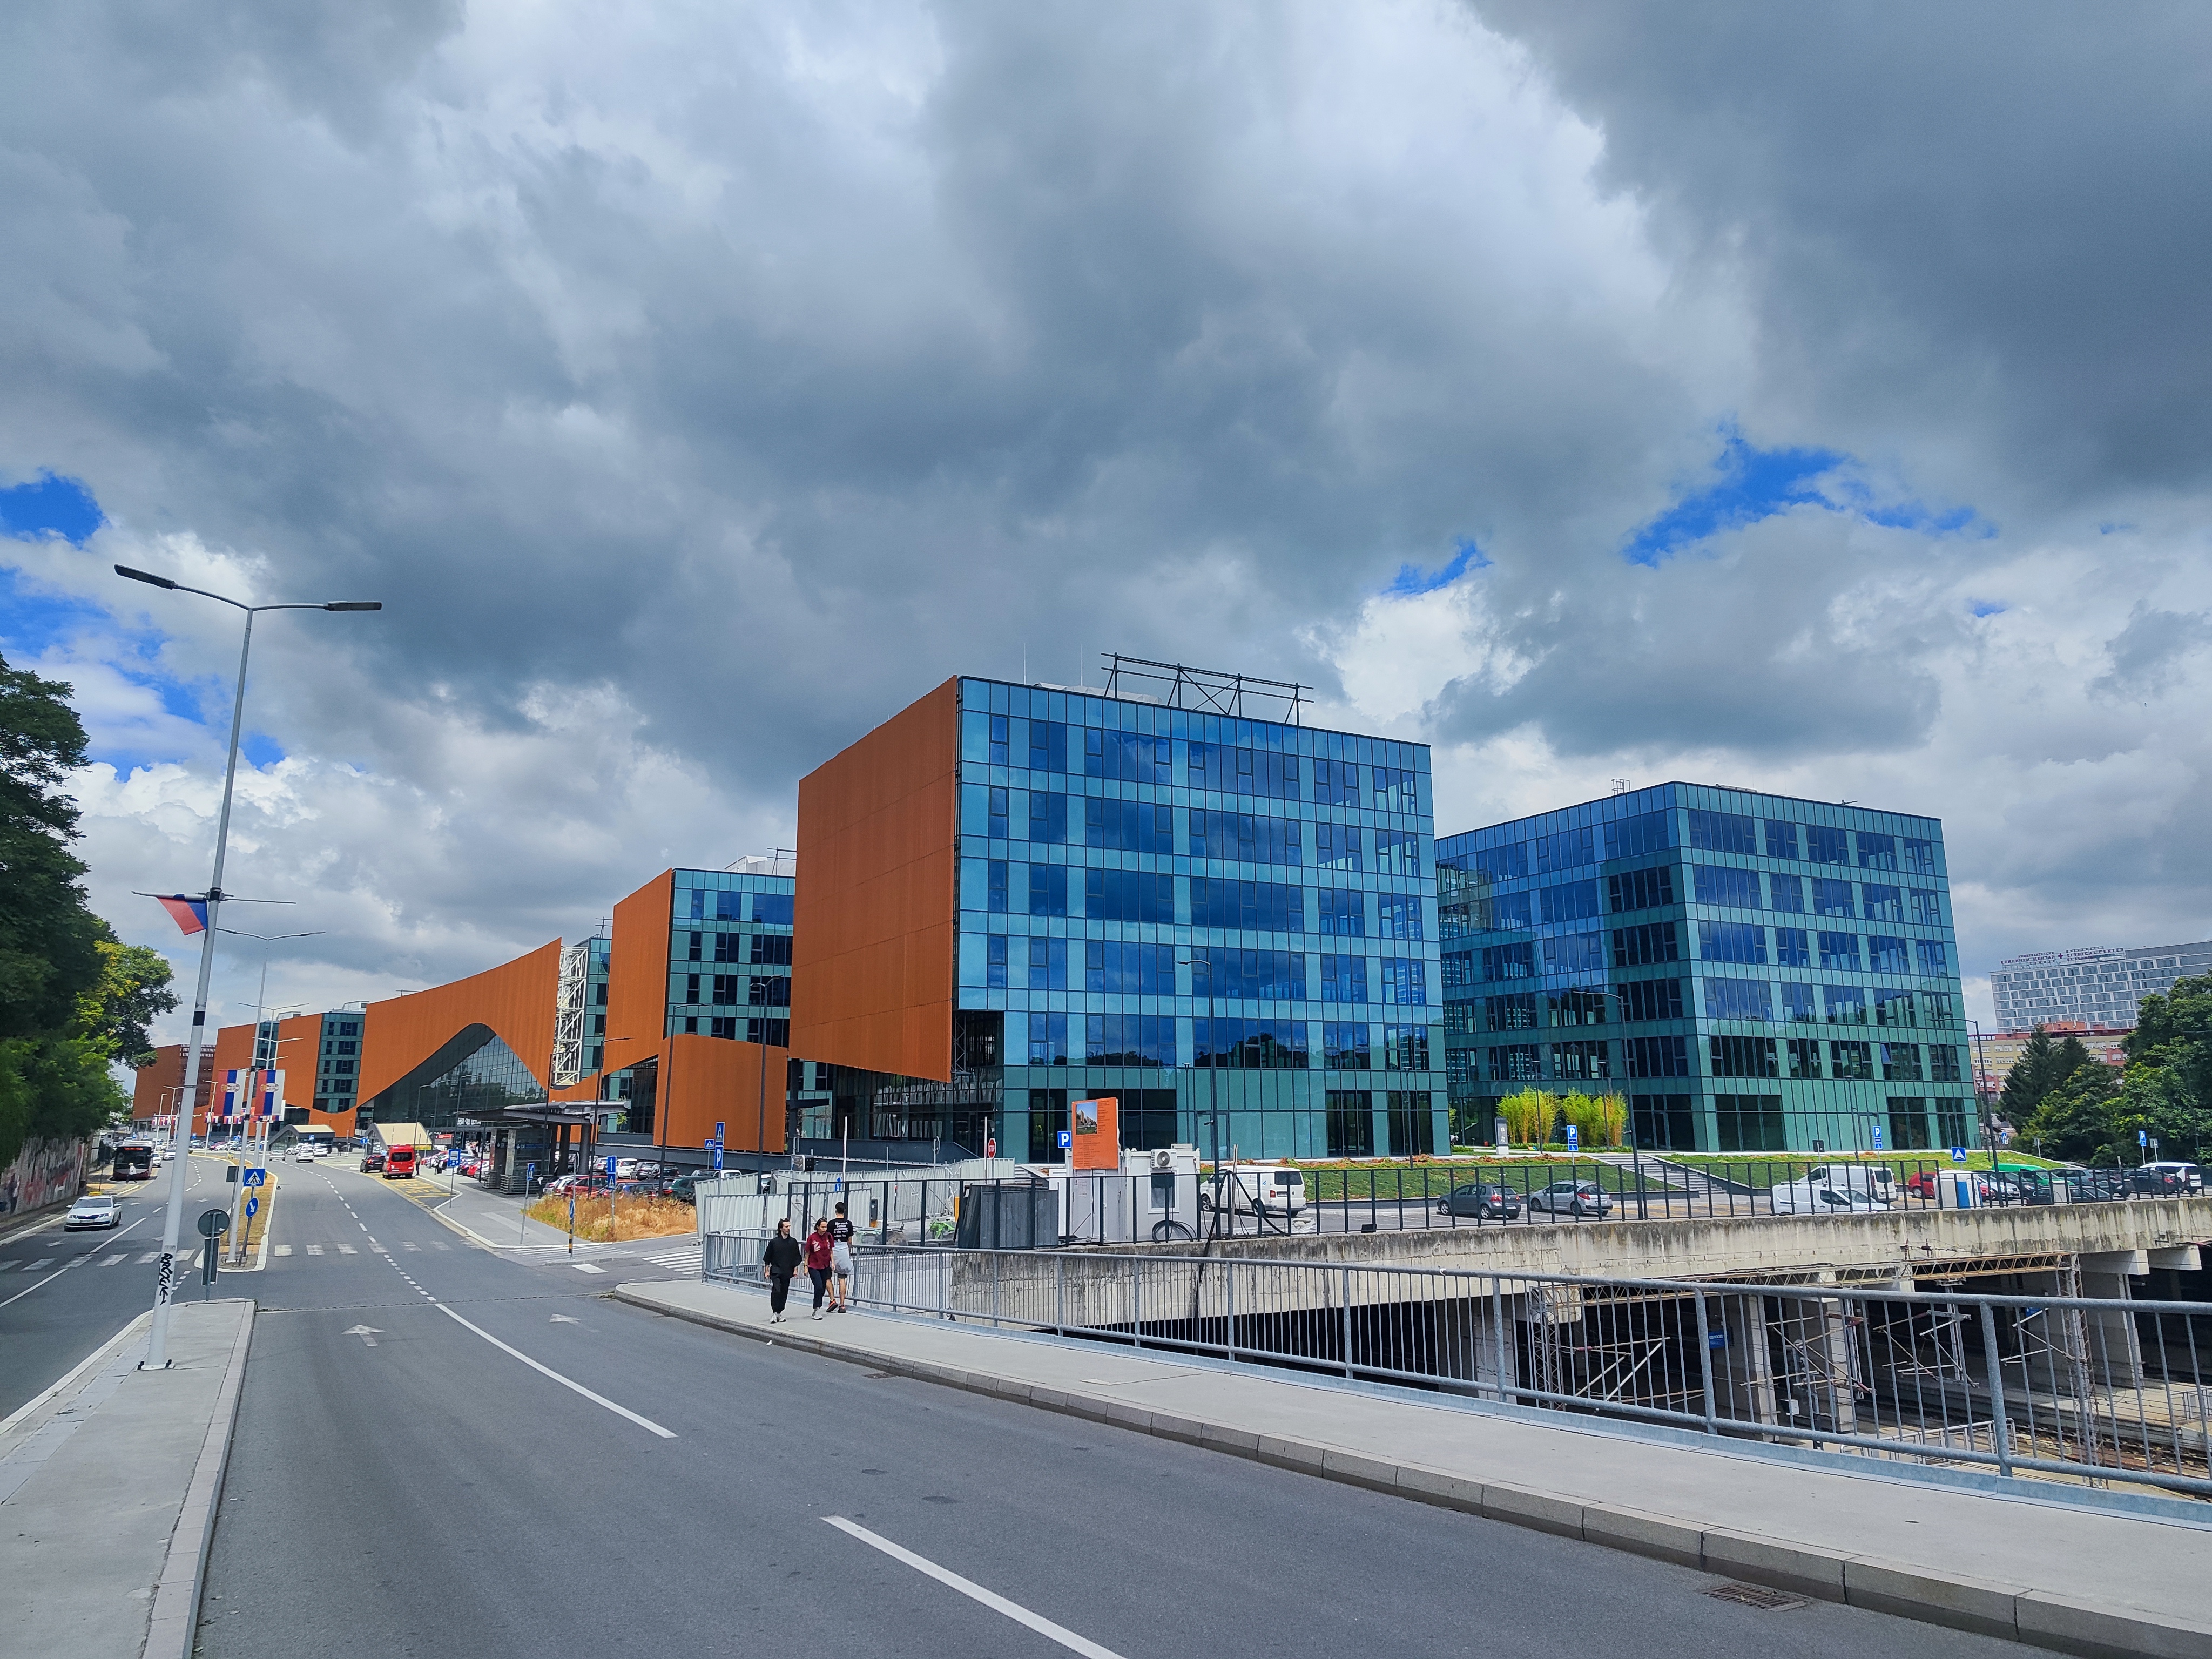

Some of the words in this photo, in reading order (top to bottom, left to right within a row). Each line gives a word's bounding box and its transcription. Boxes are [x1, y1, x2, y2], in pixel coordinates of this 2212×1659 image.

[1569, 1127, 1575, 1137] P
[1875, 1128, 1880, 1136] P
[1061, 1133, 1069, 1145] P
[716, 1149, 721, 1166] P
